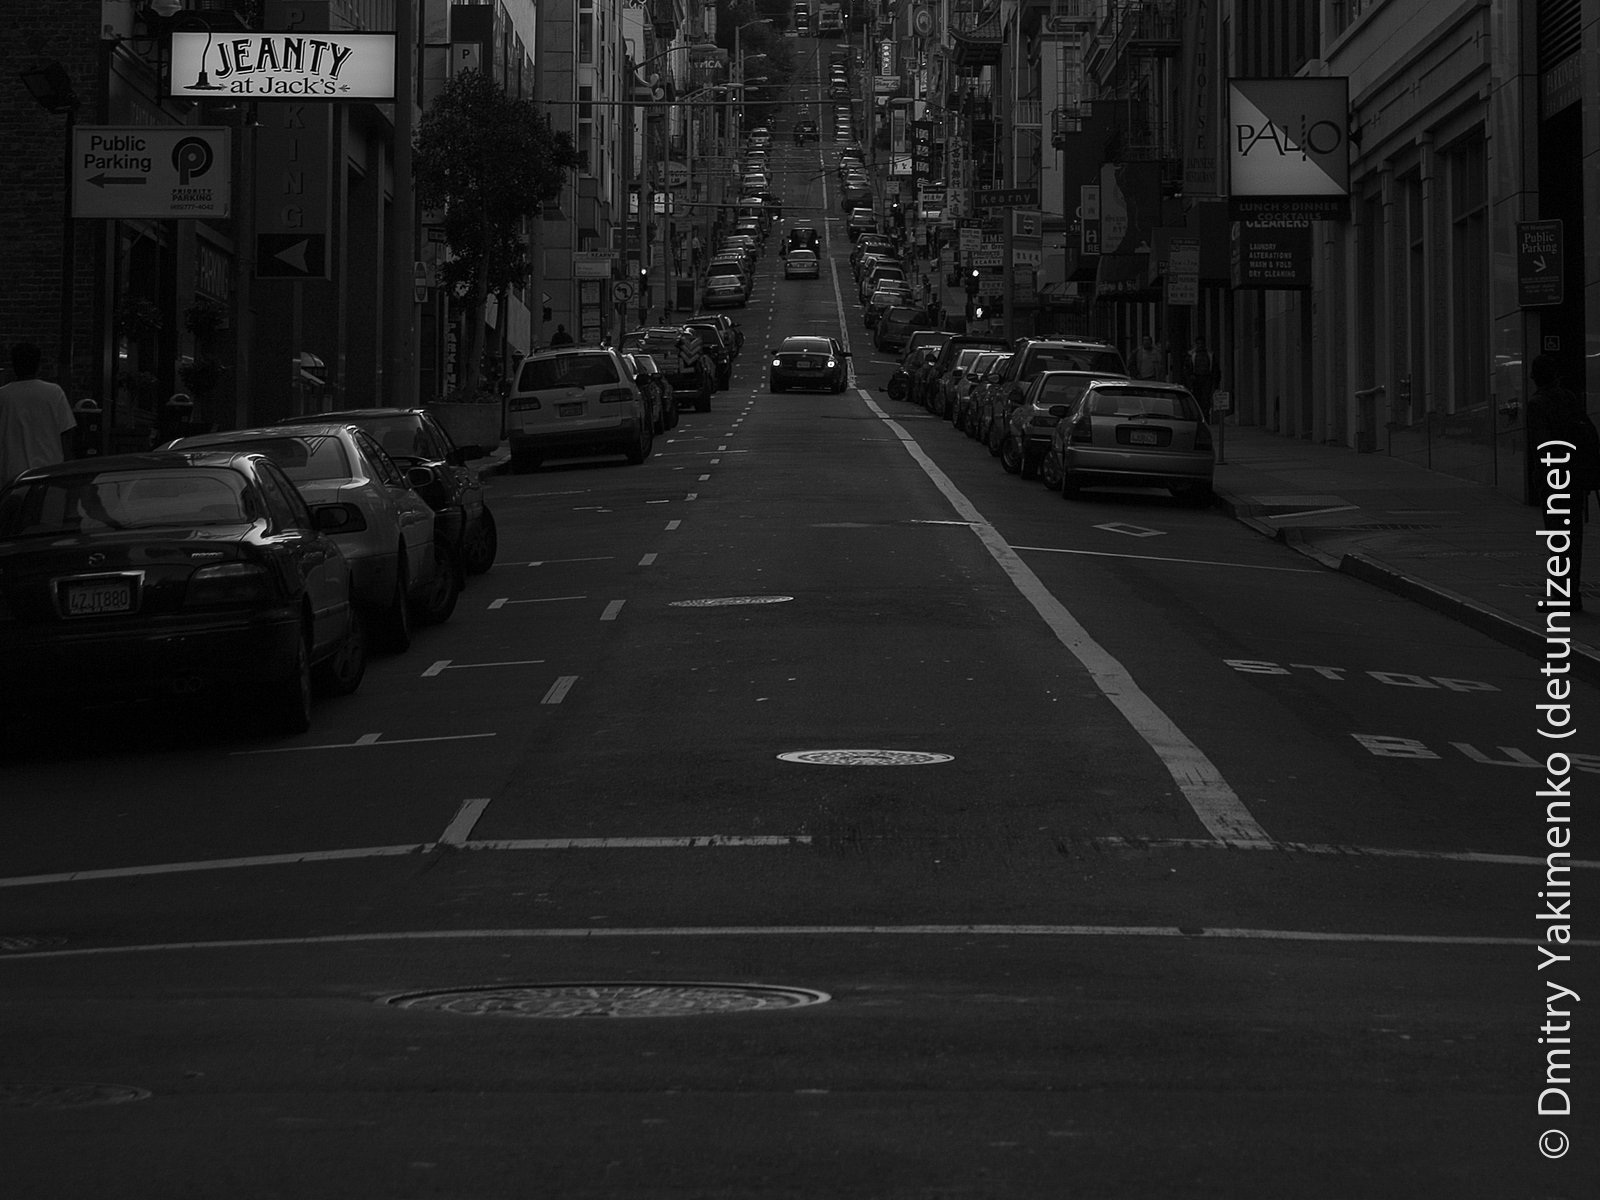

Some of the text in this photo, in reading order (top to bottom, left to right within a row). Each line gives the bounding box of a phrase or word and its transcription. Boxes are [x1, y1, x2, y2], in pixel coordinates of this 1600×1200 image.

[215, 37, 353, 81] JEANTY
[230, 77, 336, 94] at Jack's
[1197, 52, 1209, 153] HOUSE
[286, 10, 306, 229] PKING
[91, 135, 147, 151] Public
[1236, 114, 1343, 161] PALIO
[84, 153, 152, 173] Parking
[981, 194, 1031, 204] Kearny
[1239, 202, 1338, 212] LUNCH DINNER
[1257, 212, 1321, 221] COCKTAILS
[1524, 232, 1555, 243] Public
[1521, 243, 1558, 255] Parking
[1222, 659, 1502, 692] STOP
